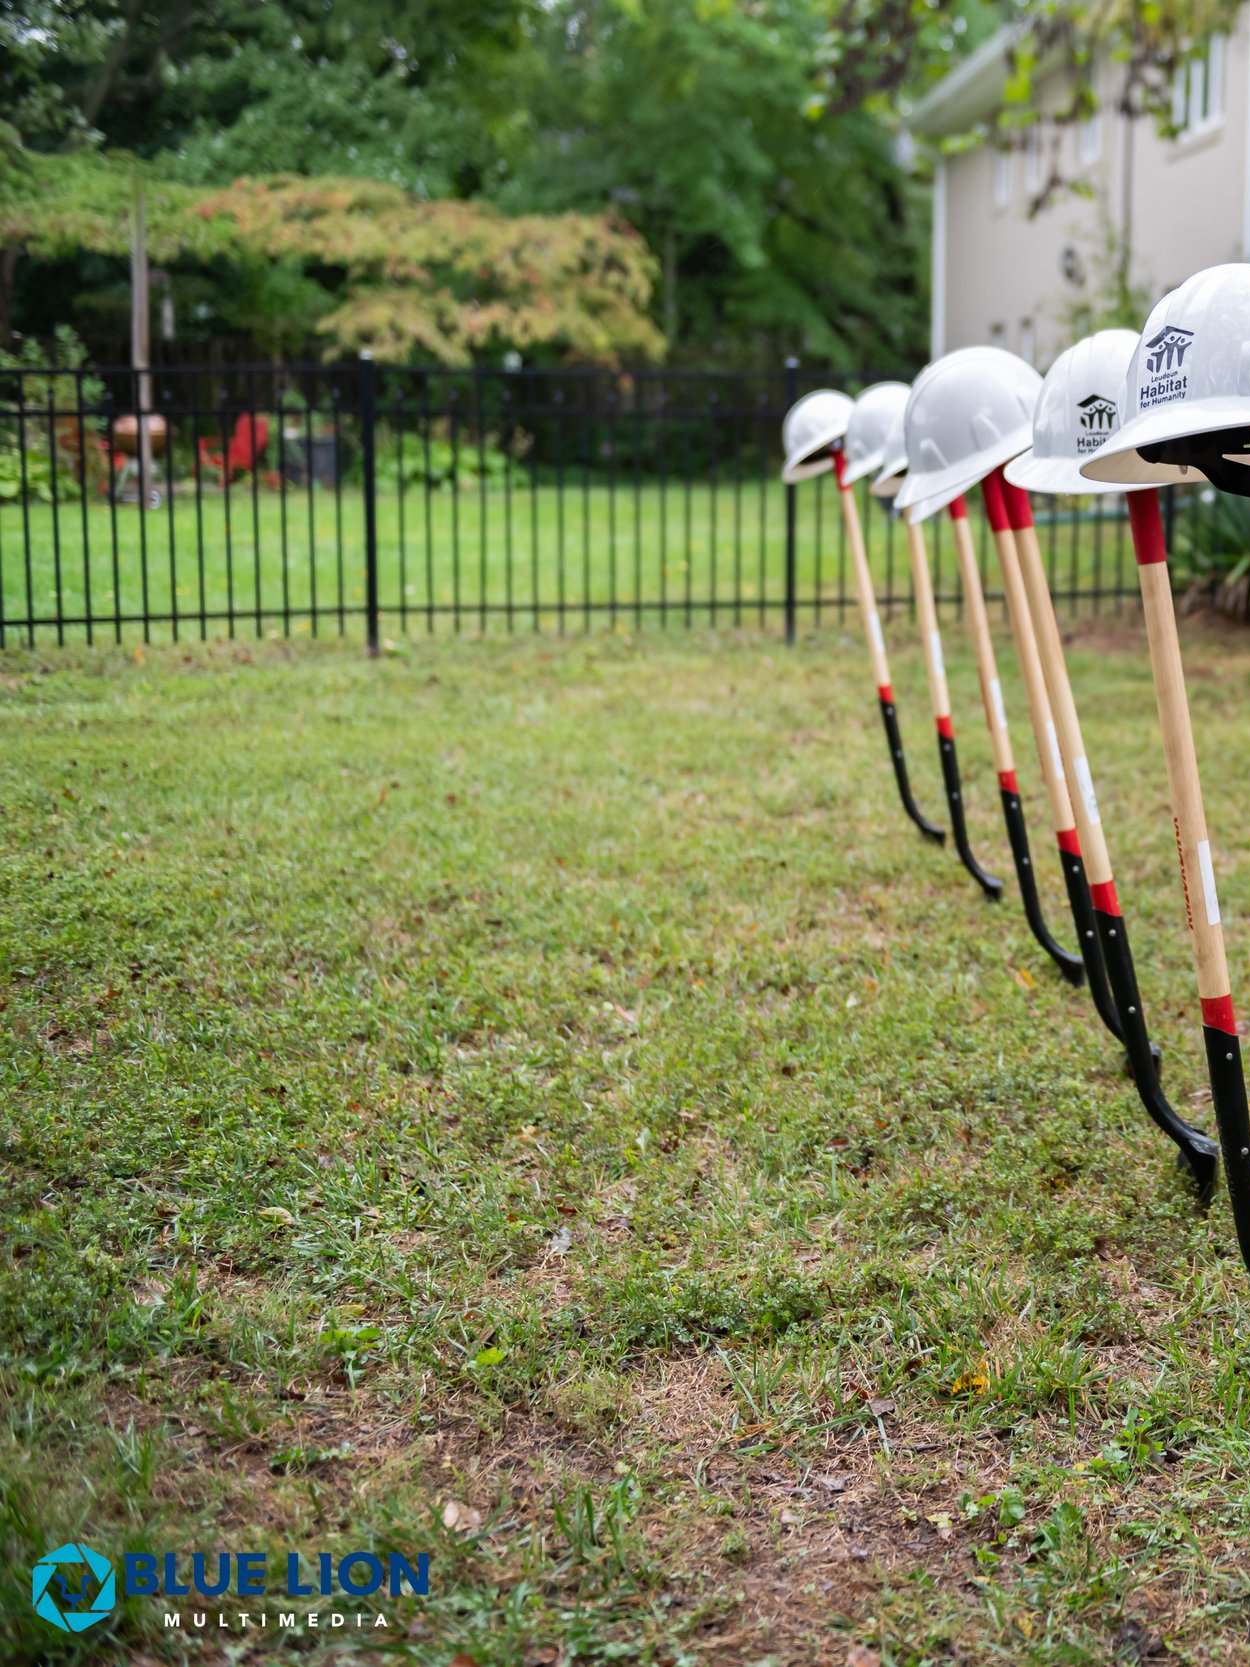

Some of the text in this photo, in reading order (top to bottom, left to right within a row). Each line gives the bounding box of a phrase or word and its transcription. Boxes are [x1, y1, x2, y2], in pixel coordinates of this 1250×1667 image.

[1151, 371, 1179, 383] Loudoun
[1140, 376, 1188, 400] Habitat
[1140, 391, 1187, 409] for Humanity
[1077, 436, 1107, 448] Habit
